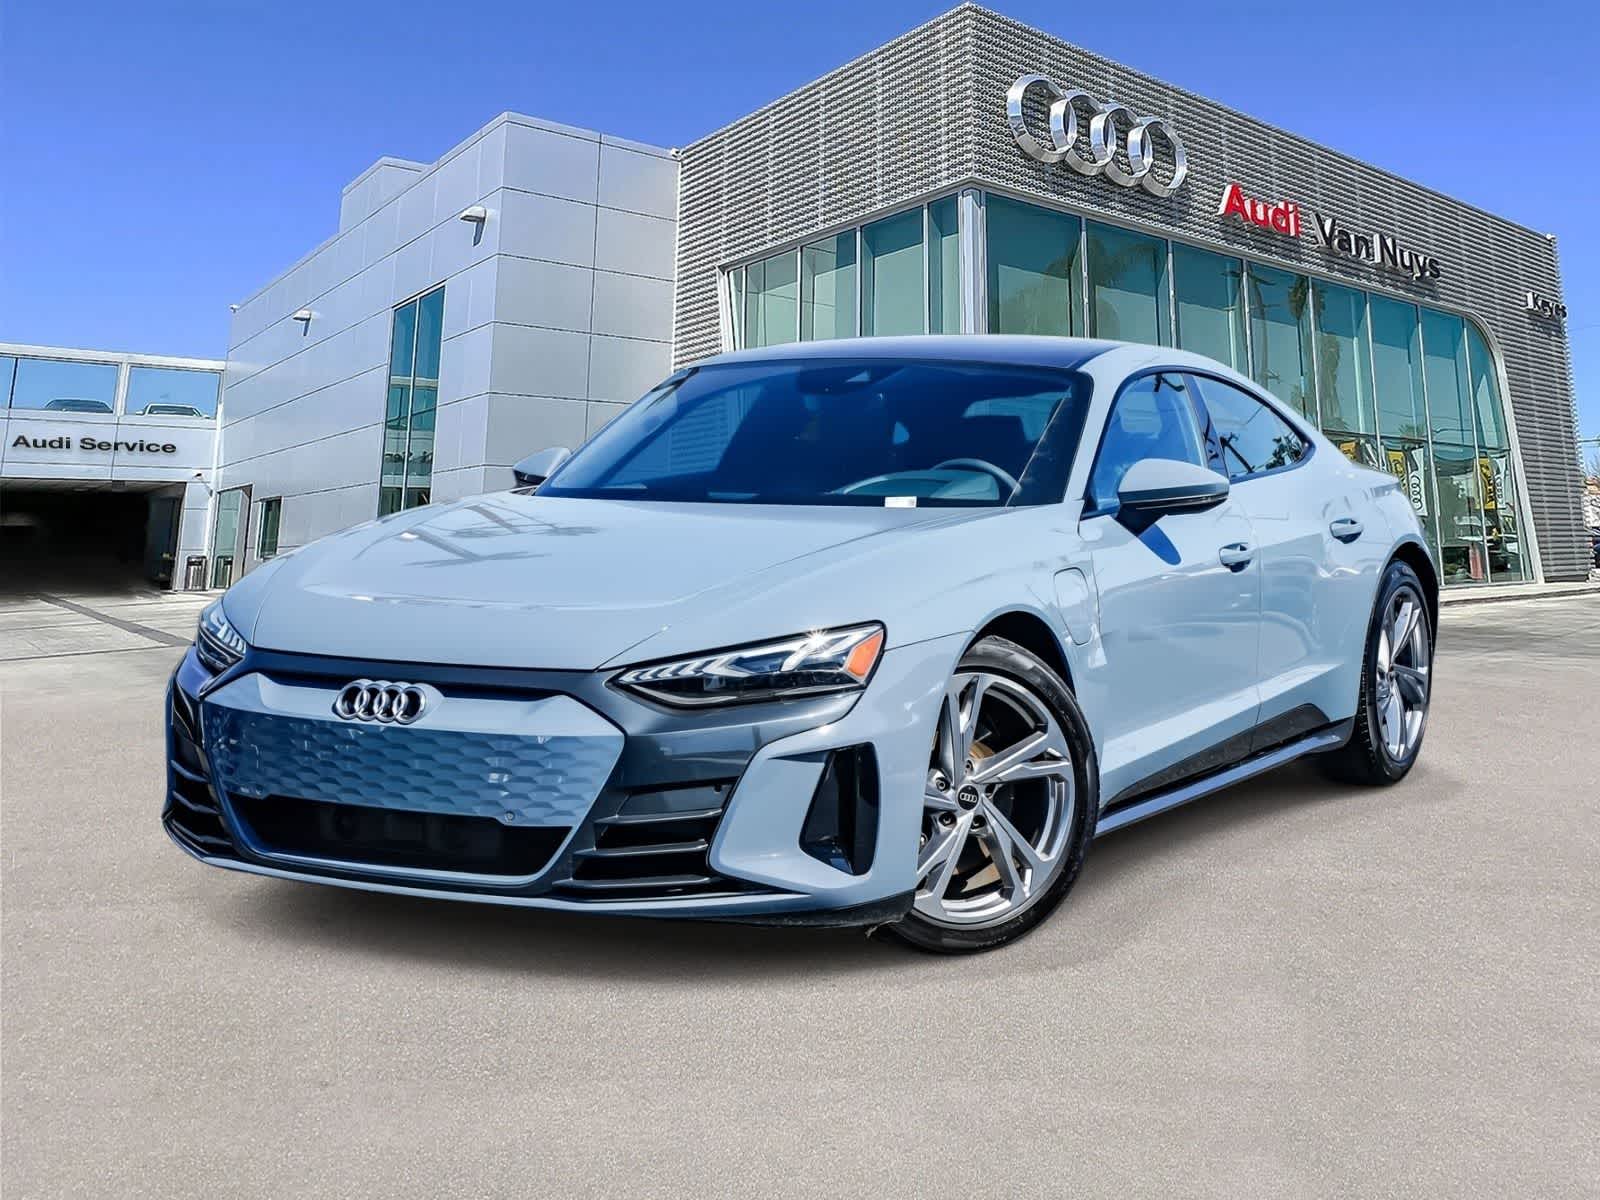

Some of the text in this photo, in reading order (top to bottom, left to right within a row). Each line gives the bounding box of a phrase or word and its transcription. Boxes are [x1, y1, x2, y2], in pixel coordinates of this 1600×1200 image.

[1217, 182, 1440, 280] Audi Van Nuys
[1527, 291, 1567, 319] Keyes
[12, 435, 177, 453] Audi Service
